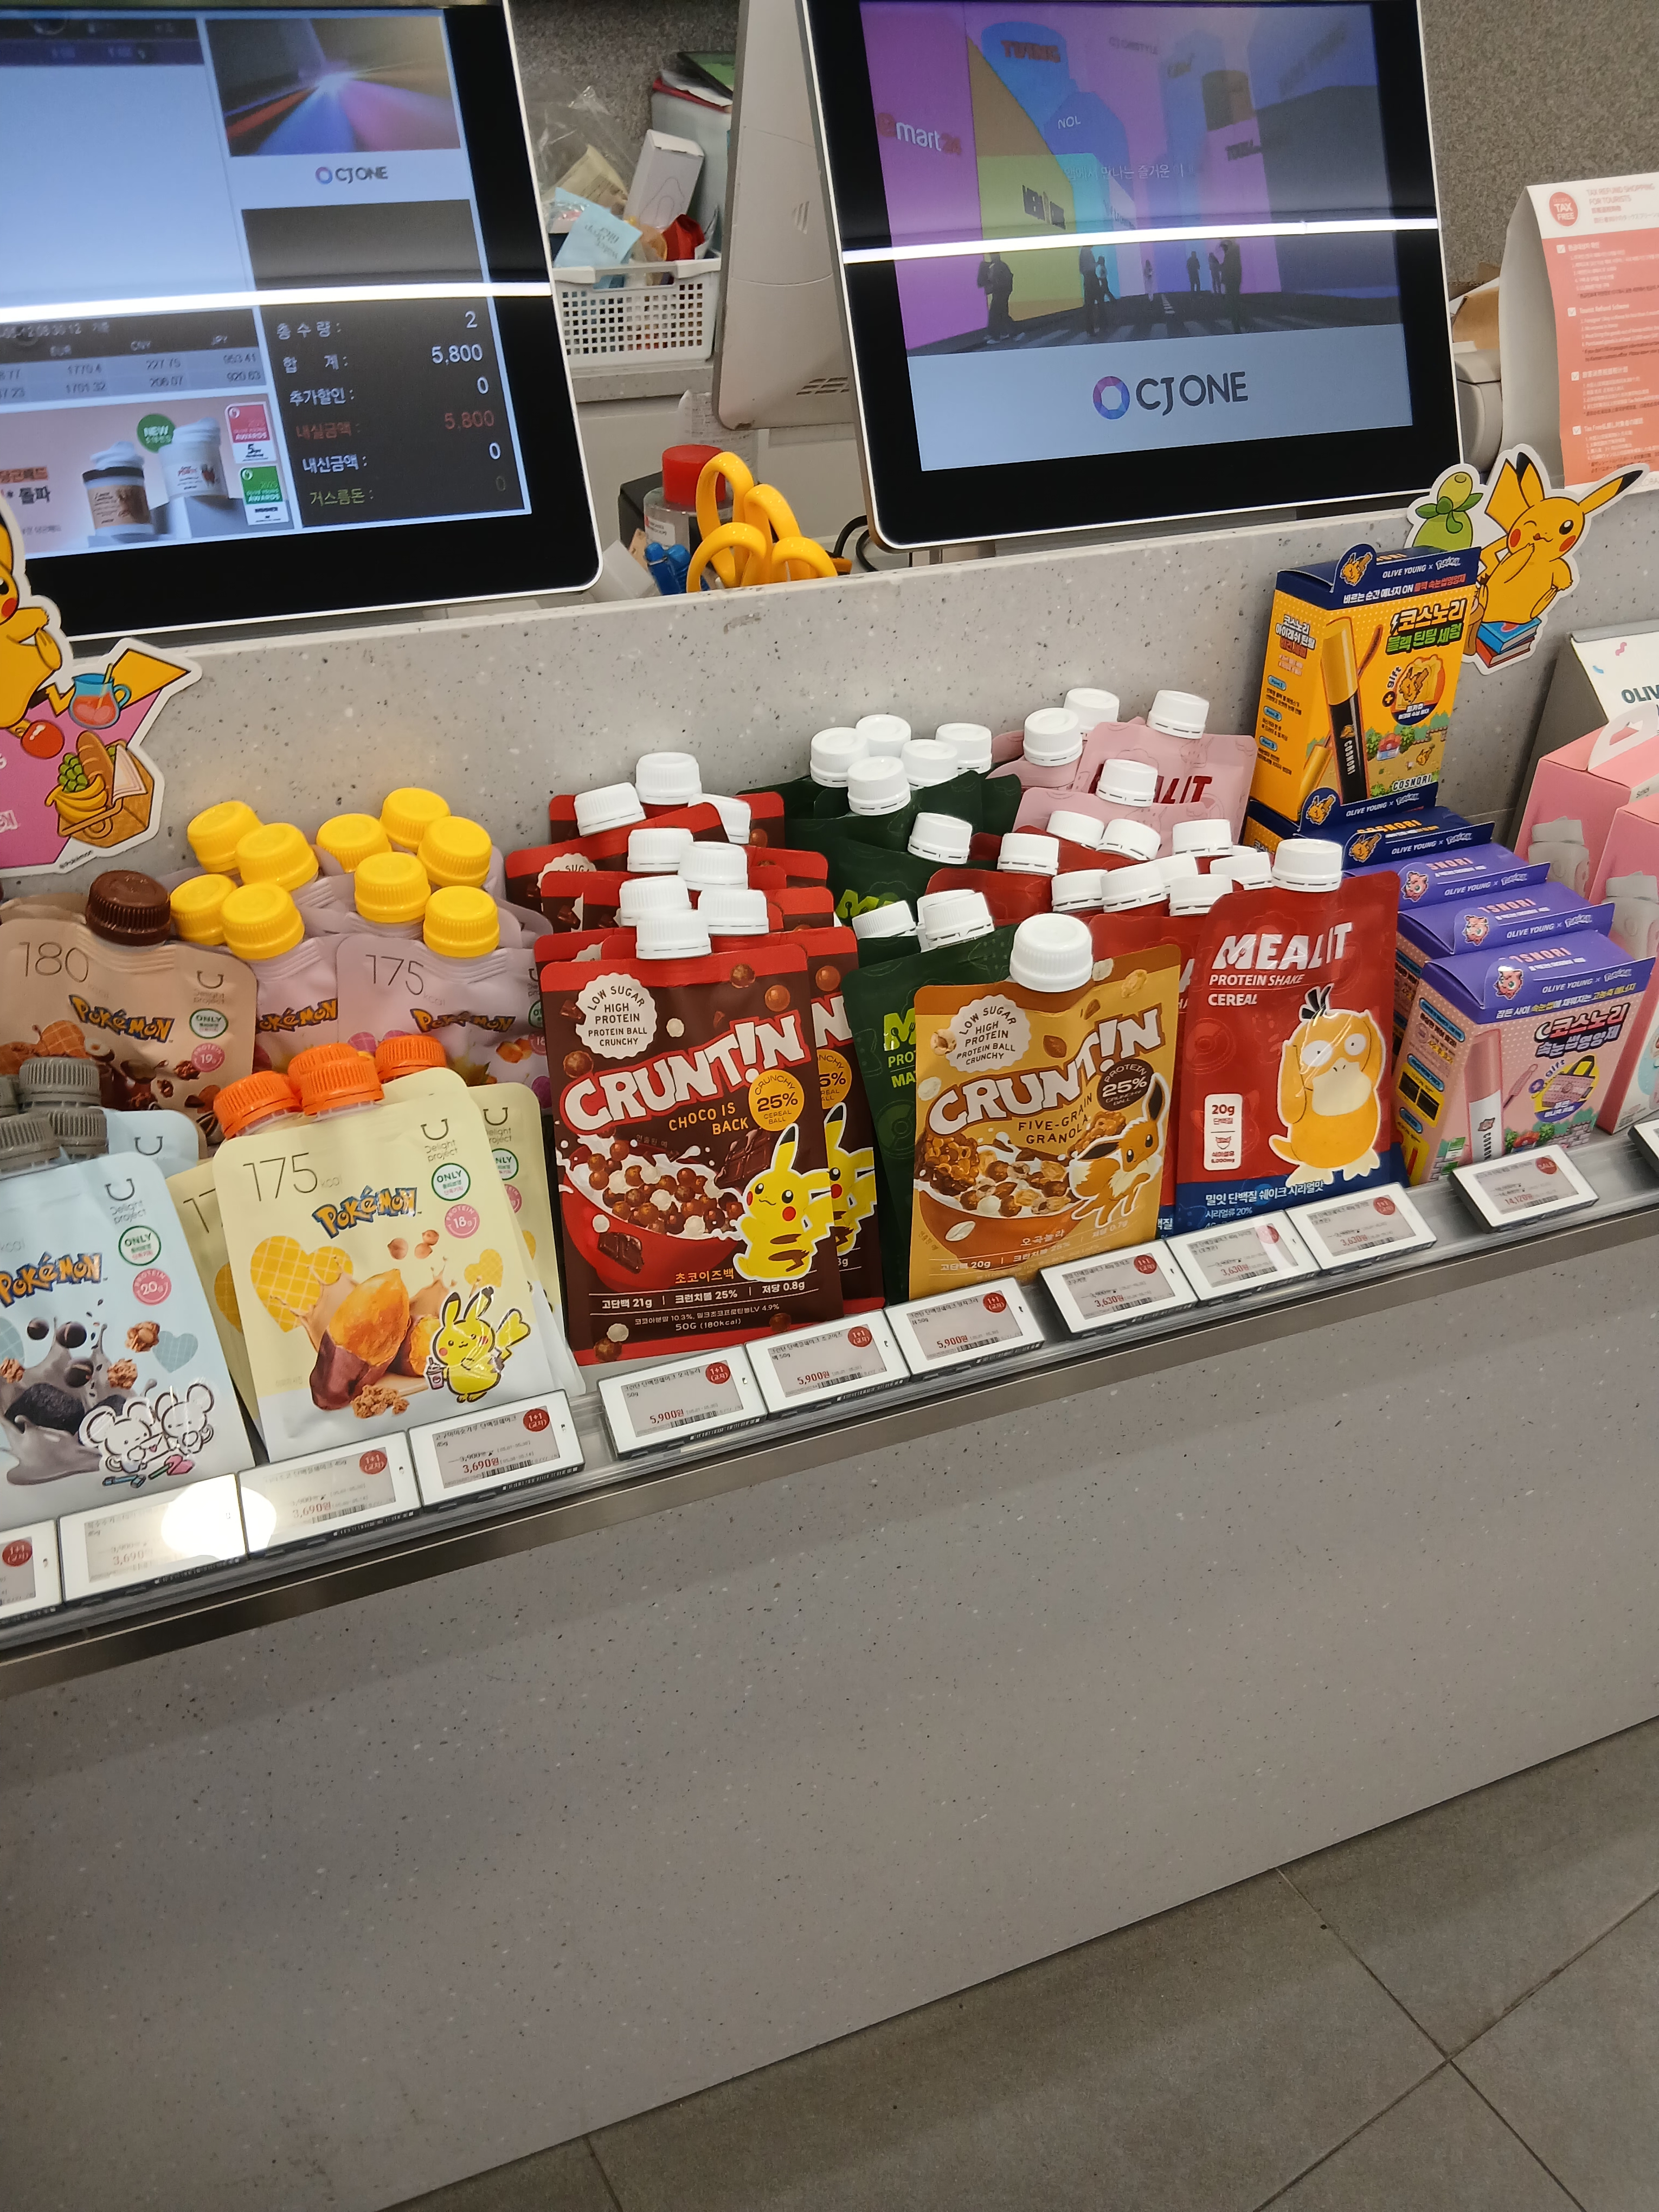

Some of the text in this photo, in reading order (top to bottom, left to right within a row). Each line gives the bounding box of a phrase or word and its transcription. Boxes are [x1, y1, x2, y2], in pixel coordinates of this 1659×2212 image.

[1057, 115, 1081, 129] NOL
[335, 166, 388, 183] CJ ONE
[1101, 165, 1135, 179] 만나는
[1138, 164, 1169, 179] 즐거운
[1554, 203, 1573, 213] TAX
[1557, 212, 1575, 221] FREE
[465, 311, 478, 328] 2
[283, 357, 297, 373] 합
[432, 344, 483, 365] 5,800
[290, 376, 488, 406] 추가할인 0
[1136, 371, 1249, 416] CJ ONE
[445, 410, 494, 431] 5,800
[144, 426, 169, 436] NEW
[489, 442, 500, 459] 0
[310, 475, 505, 506] 거스름돈 0
[1382, 564, 1426, 578] OLIVE YOUNG
[1366, 588, 1380, 601] 순간
[1381, 586, 1401, 597] 에너지
[1402, 584, 1413, 594] ON
[1398, 599, 1466, 632] 코스노리
[1283, 614, 1310, 635] 코스노리
[1275, 623, 1301, 644] 아이래쉬
[1388, 635, 1412, 652] 블랙
[1437, 622, 1462, 644] 세럼
[1387, 666, 1402, 689] gift
[1344, 740, 1355, 775] COSNORI
[1392, 774, 1432, 791] COSNORI
[1346, 802, 1387, 817] OLIVE YOUNG
[1392, 840, 1437, 855] OLIVE YOUNG
[1444, 881, 1490, 896] OLIVE YOUNG
[1506, 923, 1554, 938] OLIVE YOUNG
[1212, 922, 1354, 970] MEALIT
[19, 941, 88, 982] 180
[365, 954, 424, 995] 175
[1209, 974, 1304, 986] PROTEIN SHAKE
[1542, 978, 1592, 994] OLIVE YOUNG
[588, 986, 645, 1011] LOW SUGAR
[1208, 993, 1257, 1006] CEREAL
[605, 1002, 629, 1013] HIGH
[1496, 1008, 1513, 1019] 잠든
[1514, 1006, 1530, 1015] 사이
[196, 1014, 221, 1023] ONLY
[595, 1013, 640, 1024] PROTEIN
[959, 1006, 1016, 1036] LOW SUGAR
[1550, 1003, 1629, 1038] 코스노리
[588, 1026, 647, 1038] PROTEIN BALL
[976, 1020, 999, 1035] HIGH
[600, 1037, 639, 1047] CRUNCHY
[965, 1031, 1008, 1047] PROTEIN
[1536, 1024, 1621, 1056] 속눈썹영양제
[956, 1043, 1015, 1059] PROTEIN BALL
[966, 1053, 1005, 1065] CRUNCHY
[1104, 1065, 1148, 1083] PROTEIN
[1545, 1059, 1565, 1077] gift
[754, 1075, 795, 1095] CRUNCHY
[1102, 1078, 1148, 1097] 25%
[757, 1092, 799, 1111] 25%
[1105, 1090, 1142, 1104] CRUNCHY
[669, 1102, 736, 1131] CHOCO IS
[763, 1109, 792, 1120] CEREAL
[1018, 1092, 1093, 1131] FIVE-GRAIN
[1212, 1104, 1235, 1116] 20g
[713, 1117, 749, 1135] BACK
[768, 1116, 786, 1125] BALL
[1026, 1116, 1088, 1144] GRANOLA
[425, 1139, 457, 1154] Delight
[489, 1135, 512, 1145] roject
[1483, 1132, 1491, 1160] COSNOR
[427, 1147, 458, 1163] project
[496, 1156, 512, 1164] NLY
[1538, 1161, 1553, 1171] SALE
[243, 1152, 318, 1202] 175
[436, 1170, 462, 1183] ONLY
[1205, 1179, 1325, 1206] 밀잇 단백질 쉐이크 시리얼맛
[446, 1206, 475, 1221] PROTEIN
[1205, 1207, 1253, 1219] 시리얼류 20%
[453, 1216, 473, 1229] 18g
[1109, 1220, 1129, 1233] 0.7g
[124, 1232, 152, 1248] ONLY
[1020, 1229, 1066, 1246] 오곡놀라
[1340, 1234, 1368, 1246] 3,630원
[941, 1261, 991, 1271] 고단백 20g
[1221, 1264, 1249, 1276] 3,630원
[134, 1270, 166, 1287] PROTEIN
[675, 1267, 735, 1284] 초코이즈백
[602, 1281, 805, 1310] 고단백 21g 크런치볼 25% 저당 0.8g
[987, 1296, 1000, 1305] 1+1
[1094, 1294, 1124, 1308] 3,630원
[634, 1316, 669, 1326] 코코아분말
[761, 1303, 780, 1311] 4.9%
[676, 1318, 742, 1332] 50G (180kcal)
[852, 1330, 865, 1338] 1+1
[936, 1334, 968, 1348] 5,900원
[710, 1366, 723, 1375] 1+1
[797, 1370, 830, 1385] 5,900원
[528, 1419, 547, 1429] (교차)
[529, 1412, 542, 1420] 1+1
[650, 1409, 684, 1425] 5,900원
[365, 1455, 380, 1463] 1+1
[462, 1457, 499, 1474] 3,690원
[292, 1501, 331, 1519] 3,690원
